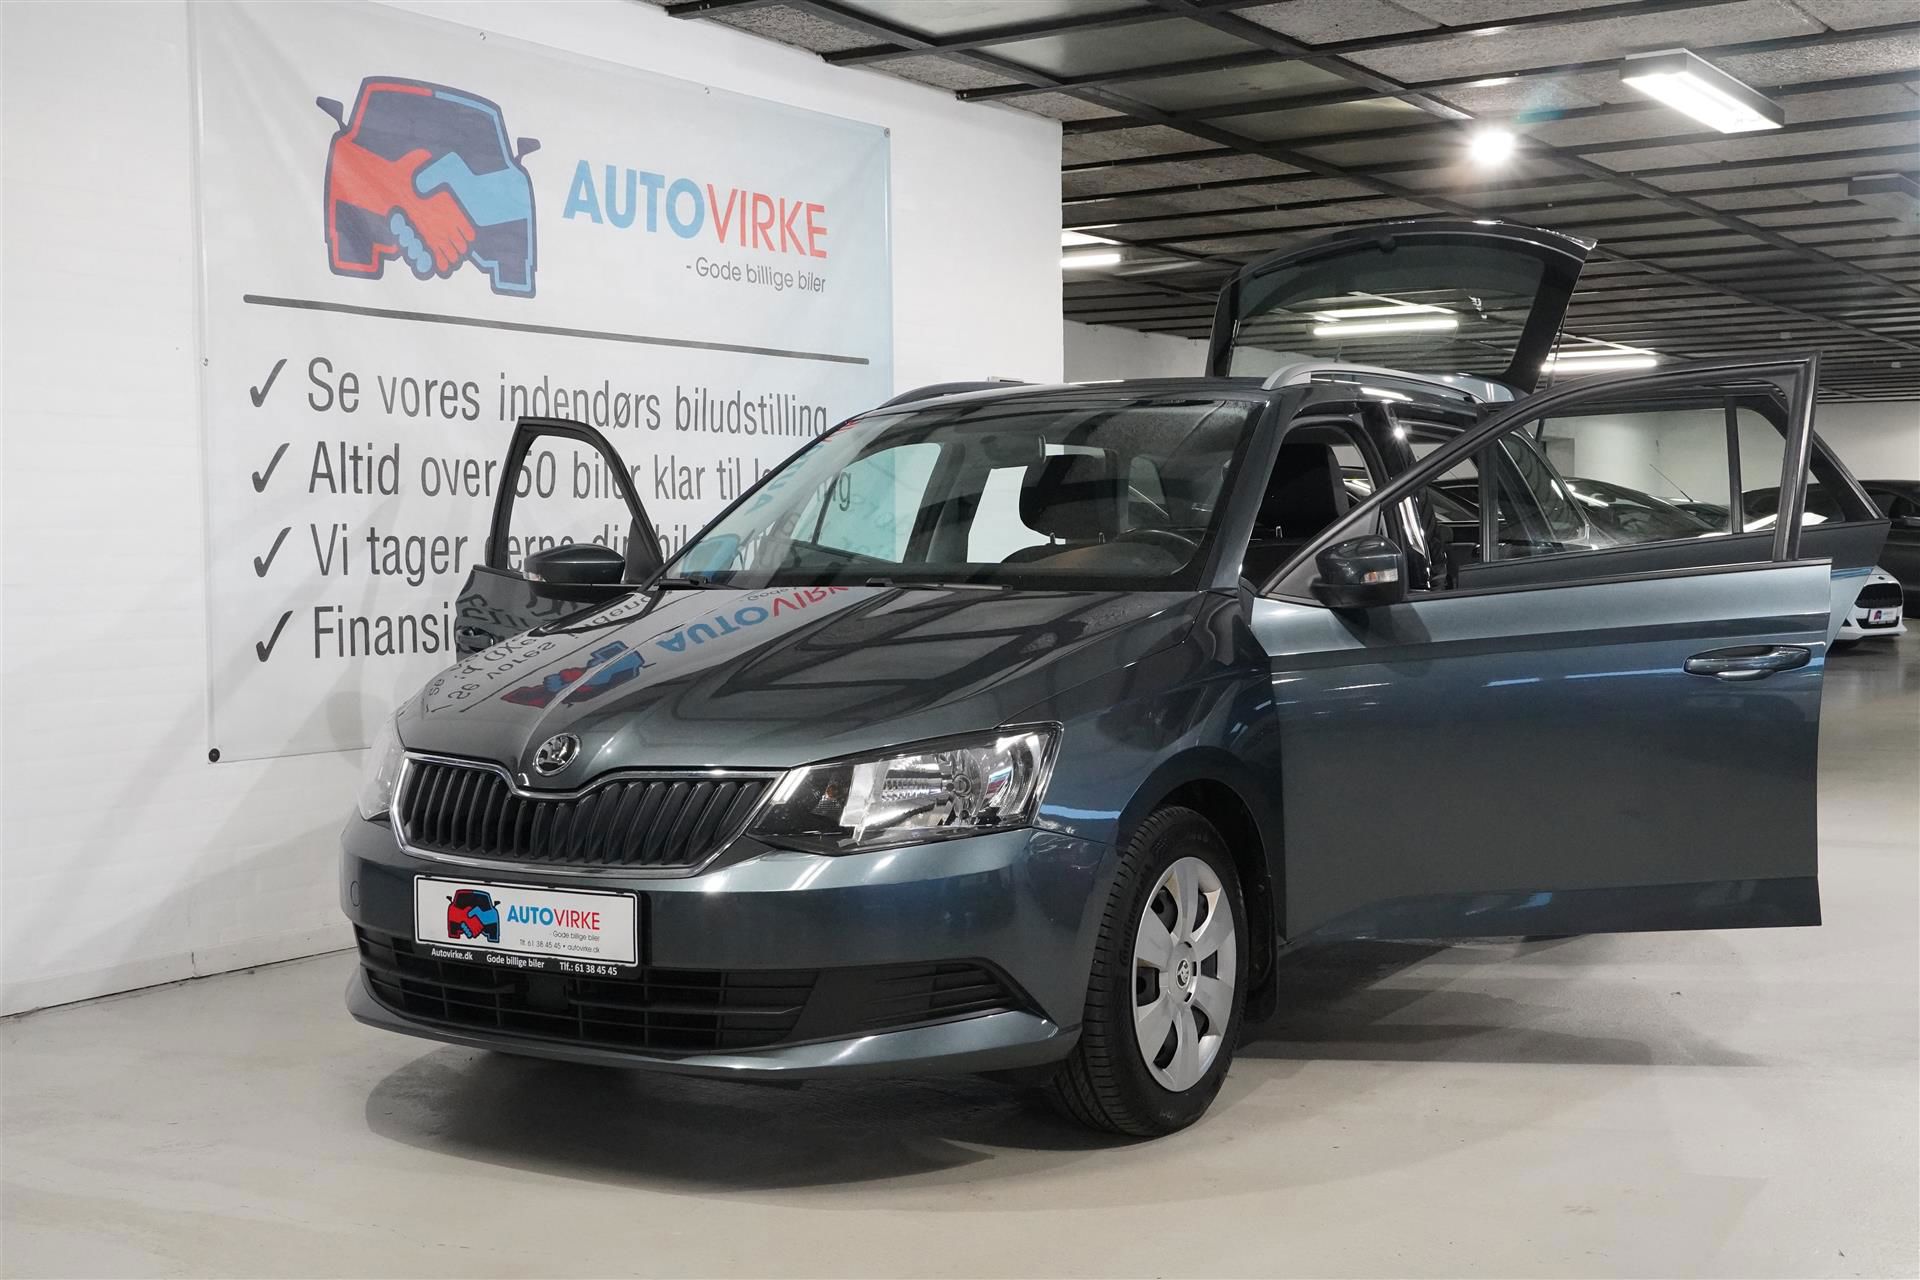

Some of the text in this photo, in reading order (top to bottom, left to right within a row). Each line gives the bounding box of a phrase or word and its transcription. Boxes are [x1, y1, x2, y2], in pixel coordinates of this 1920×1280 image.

[562, 159, 828, 259] AUTOVIRKE
[696, 257, 742, 282] Gode
[746, 264, 794, 292] billige
[798, 271, 826, 293] biler
[308, 356, 360, 413] Se
[377, 375, 481, 421] vores
[499, 371, 661, 430] indendørs
[308, 440, 400, 495] Altid
[421, 456, 497, 497] over
[654, 454, 706, 500] klar
[716, 456, 742, 500] til
[310, 523, 349, 576] Vi
[366, 526, 468, 587] tager
[507, 905, 600, 930] AUTOVIRKE
[553, 930, 570, 939] Gode
[431, 948, 473, 961] Autovirke.dk
[486, 954, 505, 964] Gode
[506, 956, 528, 968] billige
[528, 959, 545, 969] biler
[575, 964, 584, 973] 61
[586, 965, 595, 974] 38
[597, 966, 607, 975] 45
[608, 966, 618, 976] 45
